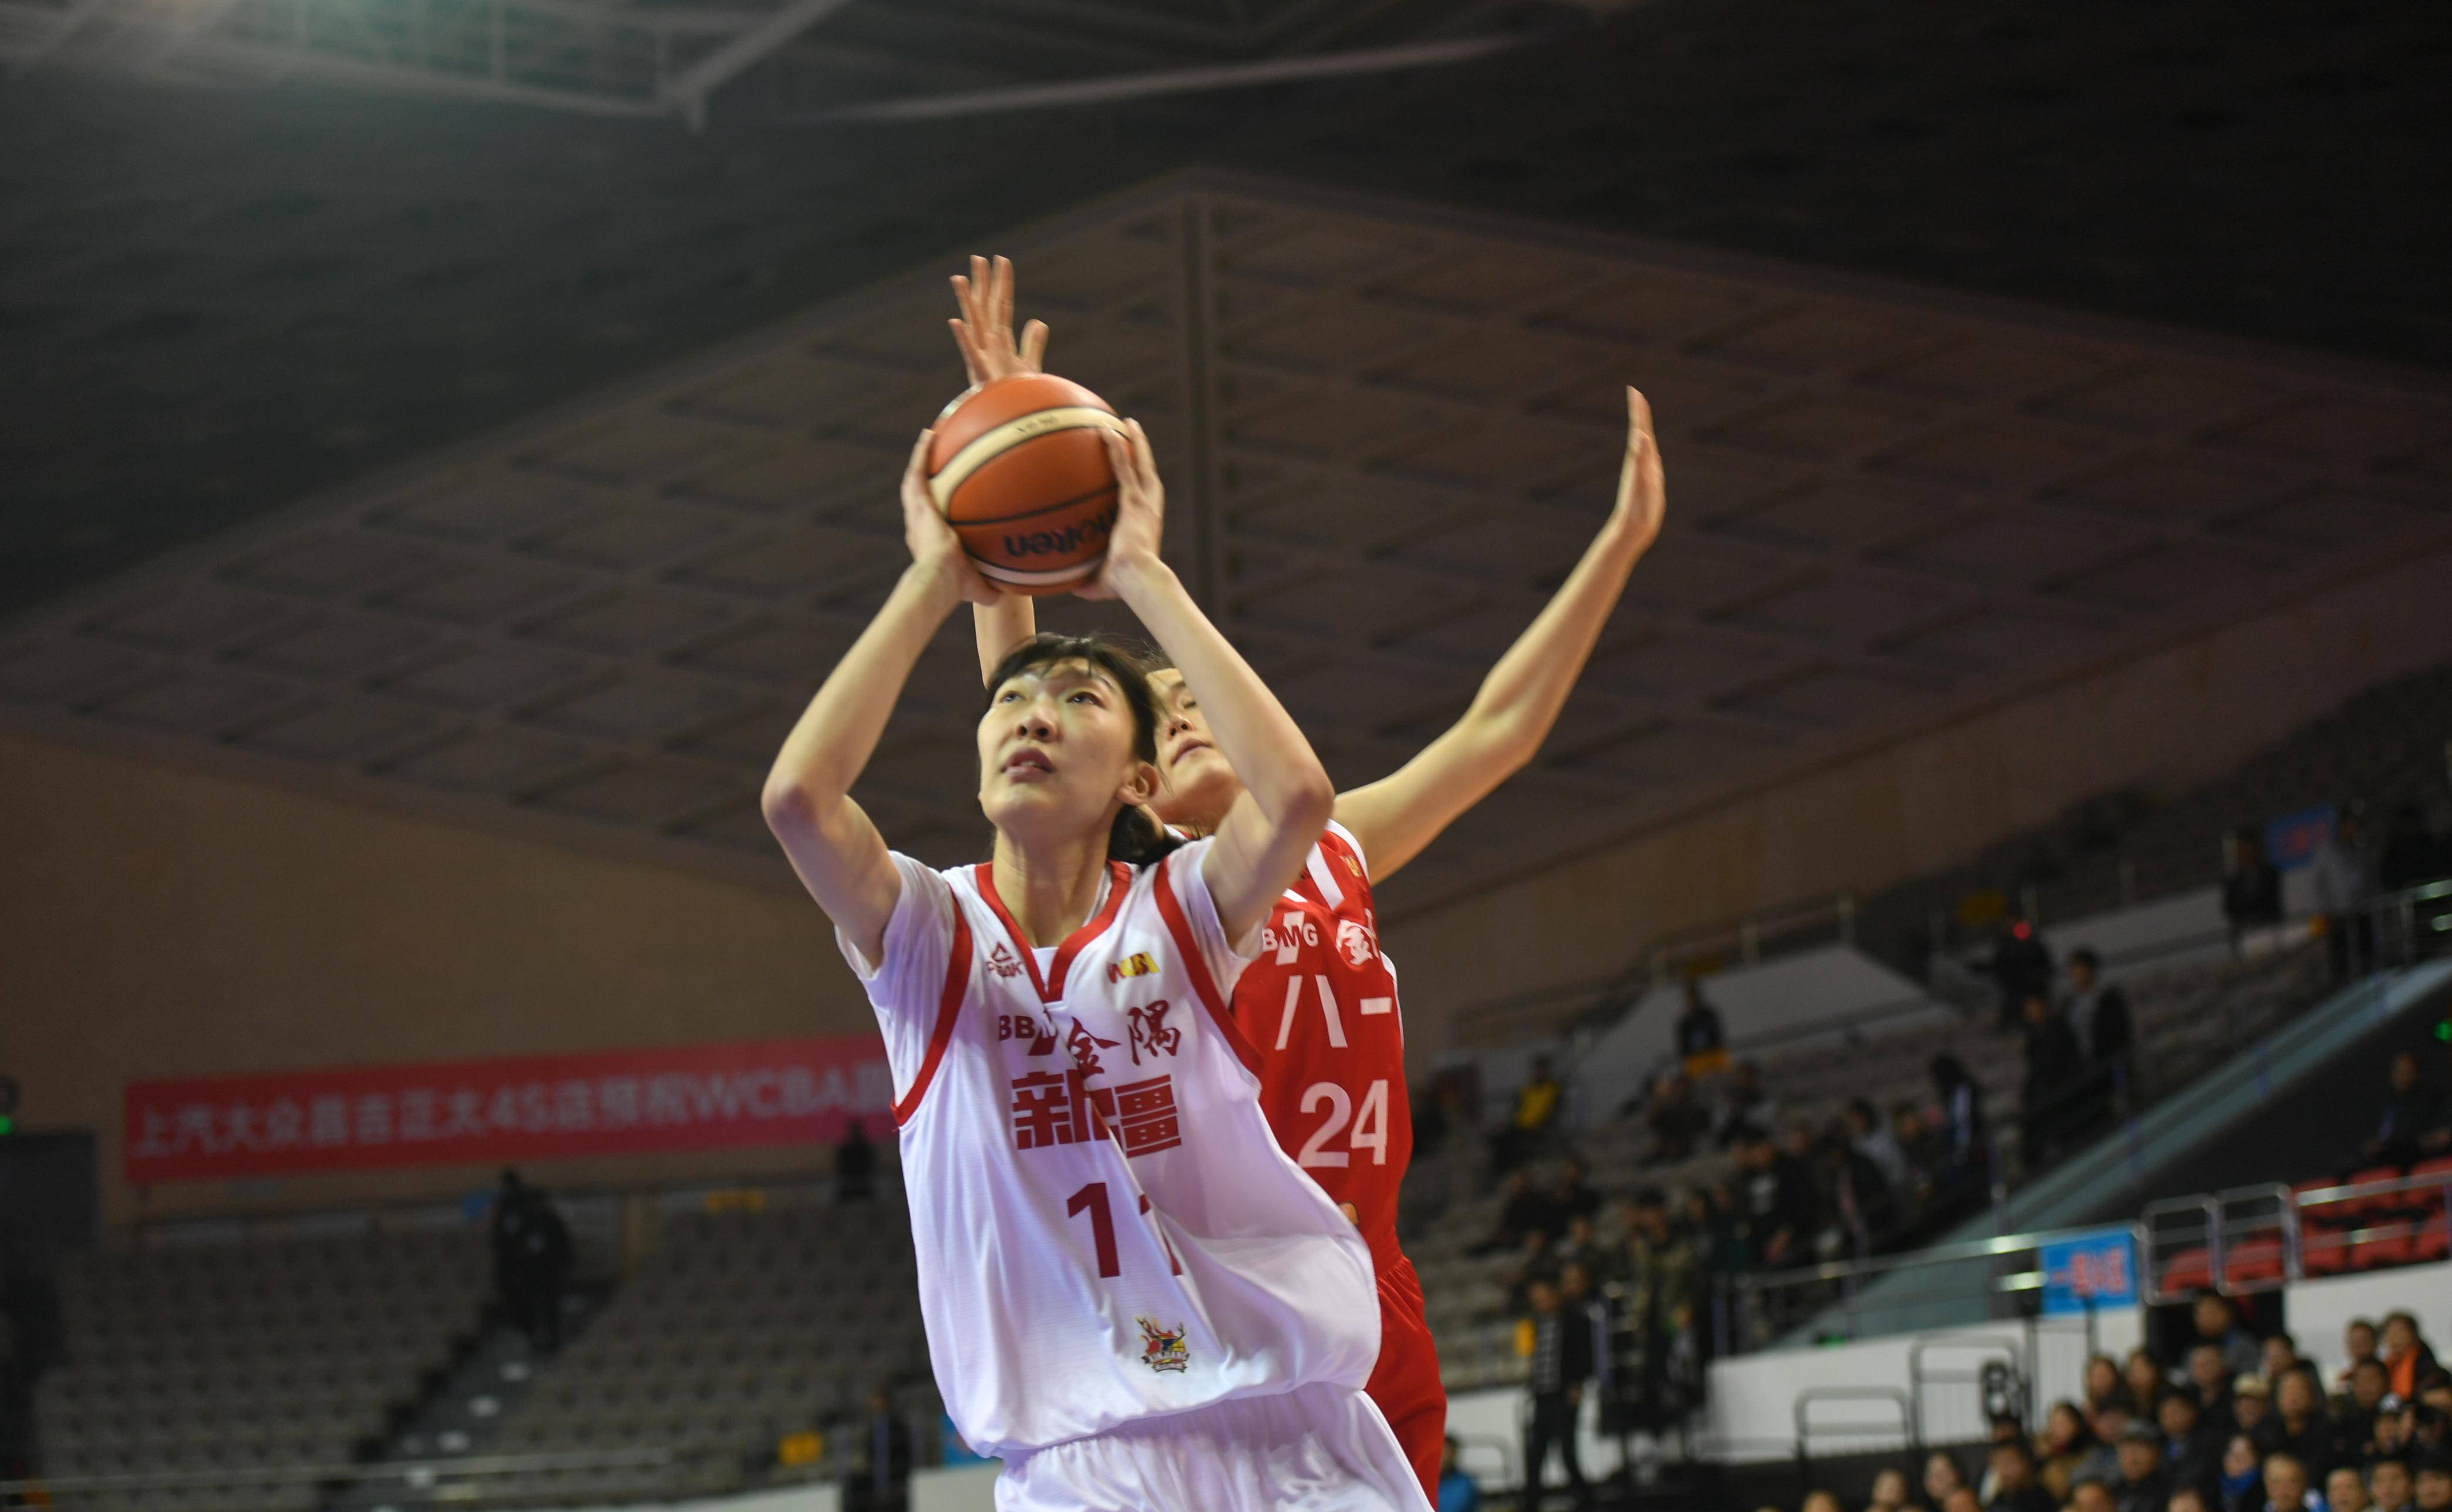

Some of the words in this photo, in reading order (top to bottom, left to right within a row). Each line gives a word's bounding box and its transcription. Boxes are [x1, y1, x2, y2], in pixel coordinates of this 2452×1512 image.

[1336, 908, 1380, 967] 金
[1067, 999, 1181, 1080] 金隅
[1275, 975, 1392, 1050] 八一
[1012, 1069, 1181, 1159] 新疆
[1298, 1079, 1388, 1168] 24
